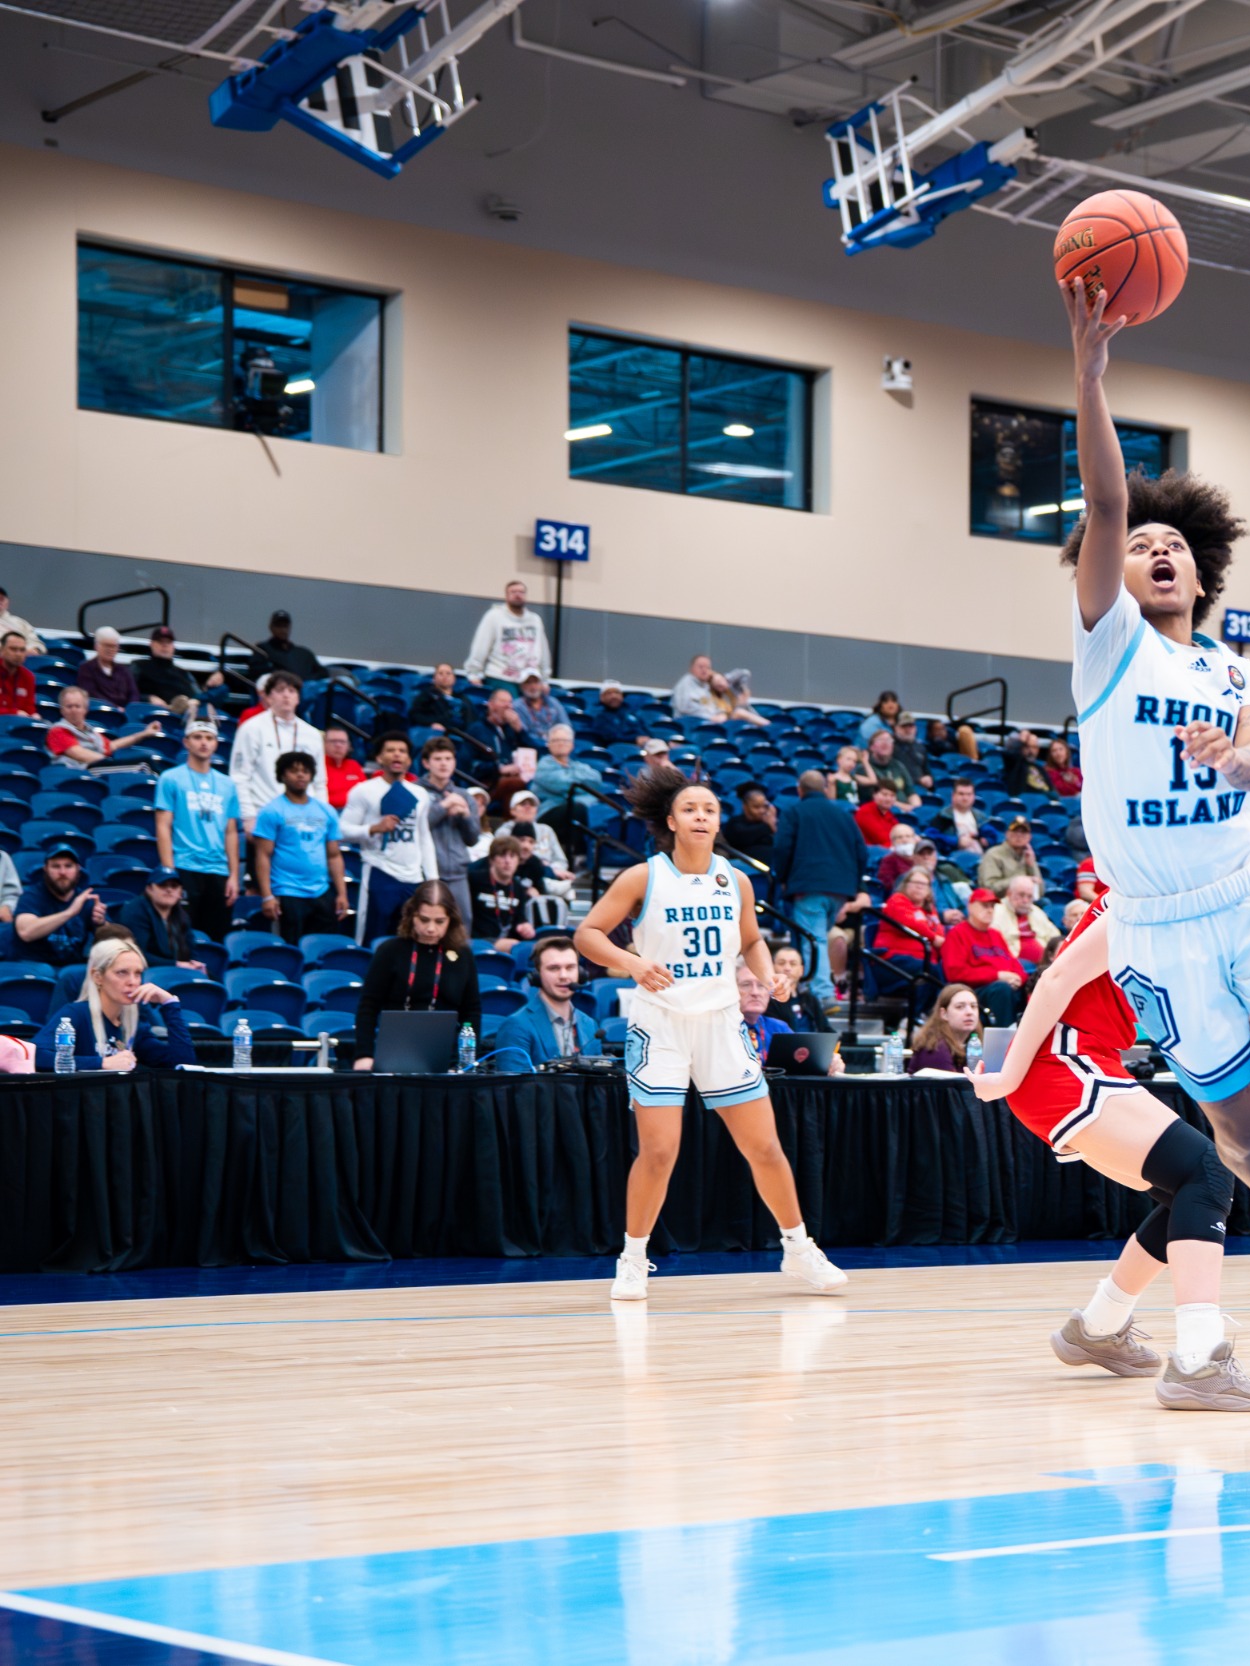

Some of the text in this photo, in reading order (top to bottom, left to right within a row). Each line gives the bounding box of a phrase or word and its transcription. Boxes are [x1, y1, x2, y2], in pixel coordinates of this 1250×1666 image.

[539, 525, 586, 555] 314
[1134, 694, 1233, 737] RHOD
[1126, 791, 1246, 827] ISLAND
[665, 906, 733, 923] RHODE
[683, 926, 722, 958] 30
[665, 961, 723, 979] SLAN
